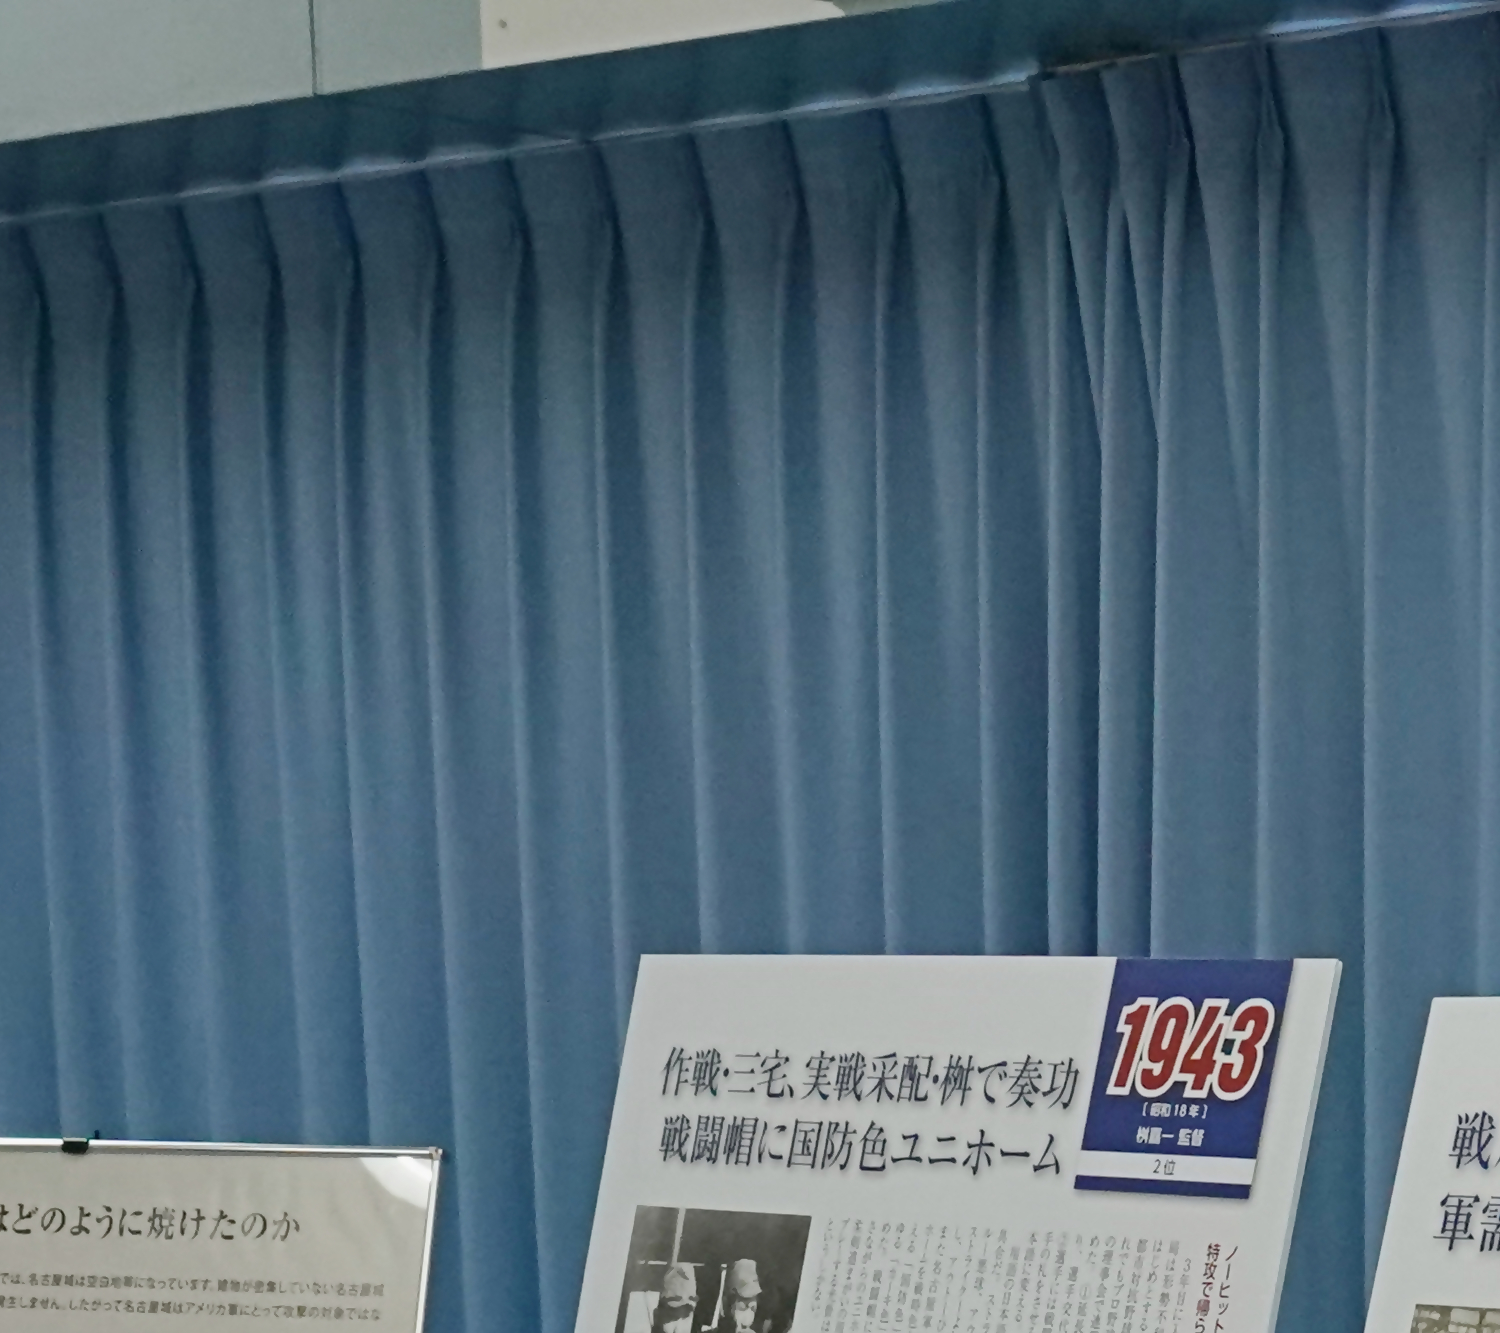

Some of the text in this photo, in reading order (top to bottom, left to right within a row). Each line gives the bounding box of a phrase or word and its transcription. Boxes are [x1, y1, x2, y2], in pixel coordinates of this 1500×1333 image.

[661, 1046, 1080, 1111] 作戦・三宅、実戦采配・桝で奏功
[1106, 996, 1276, 1101] 1943
[658, 1113, 1062, 1176] 戦闘帽に国防色ユニホーム
[1152, 1159, 1176, 1176] 2位
